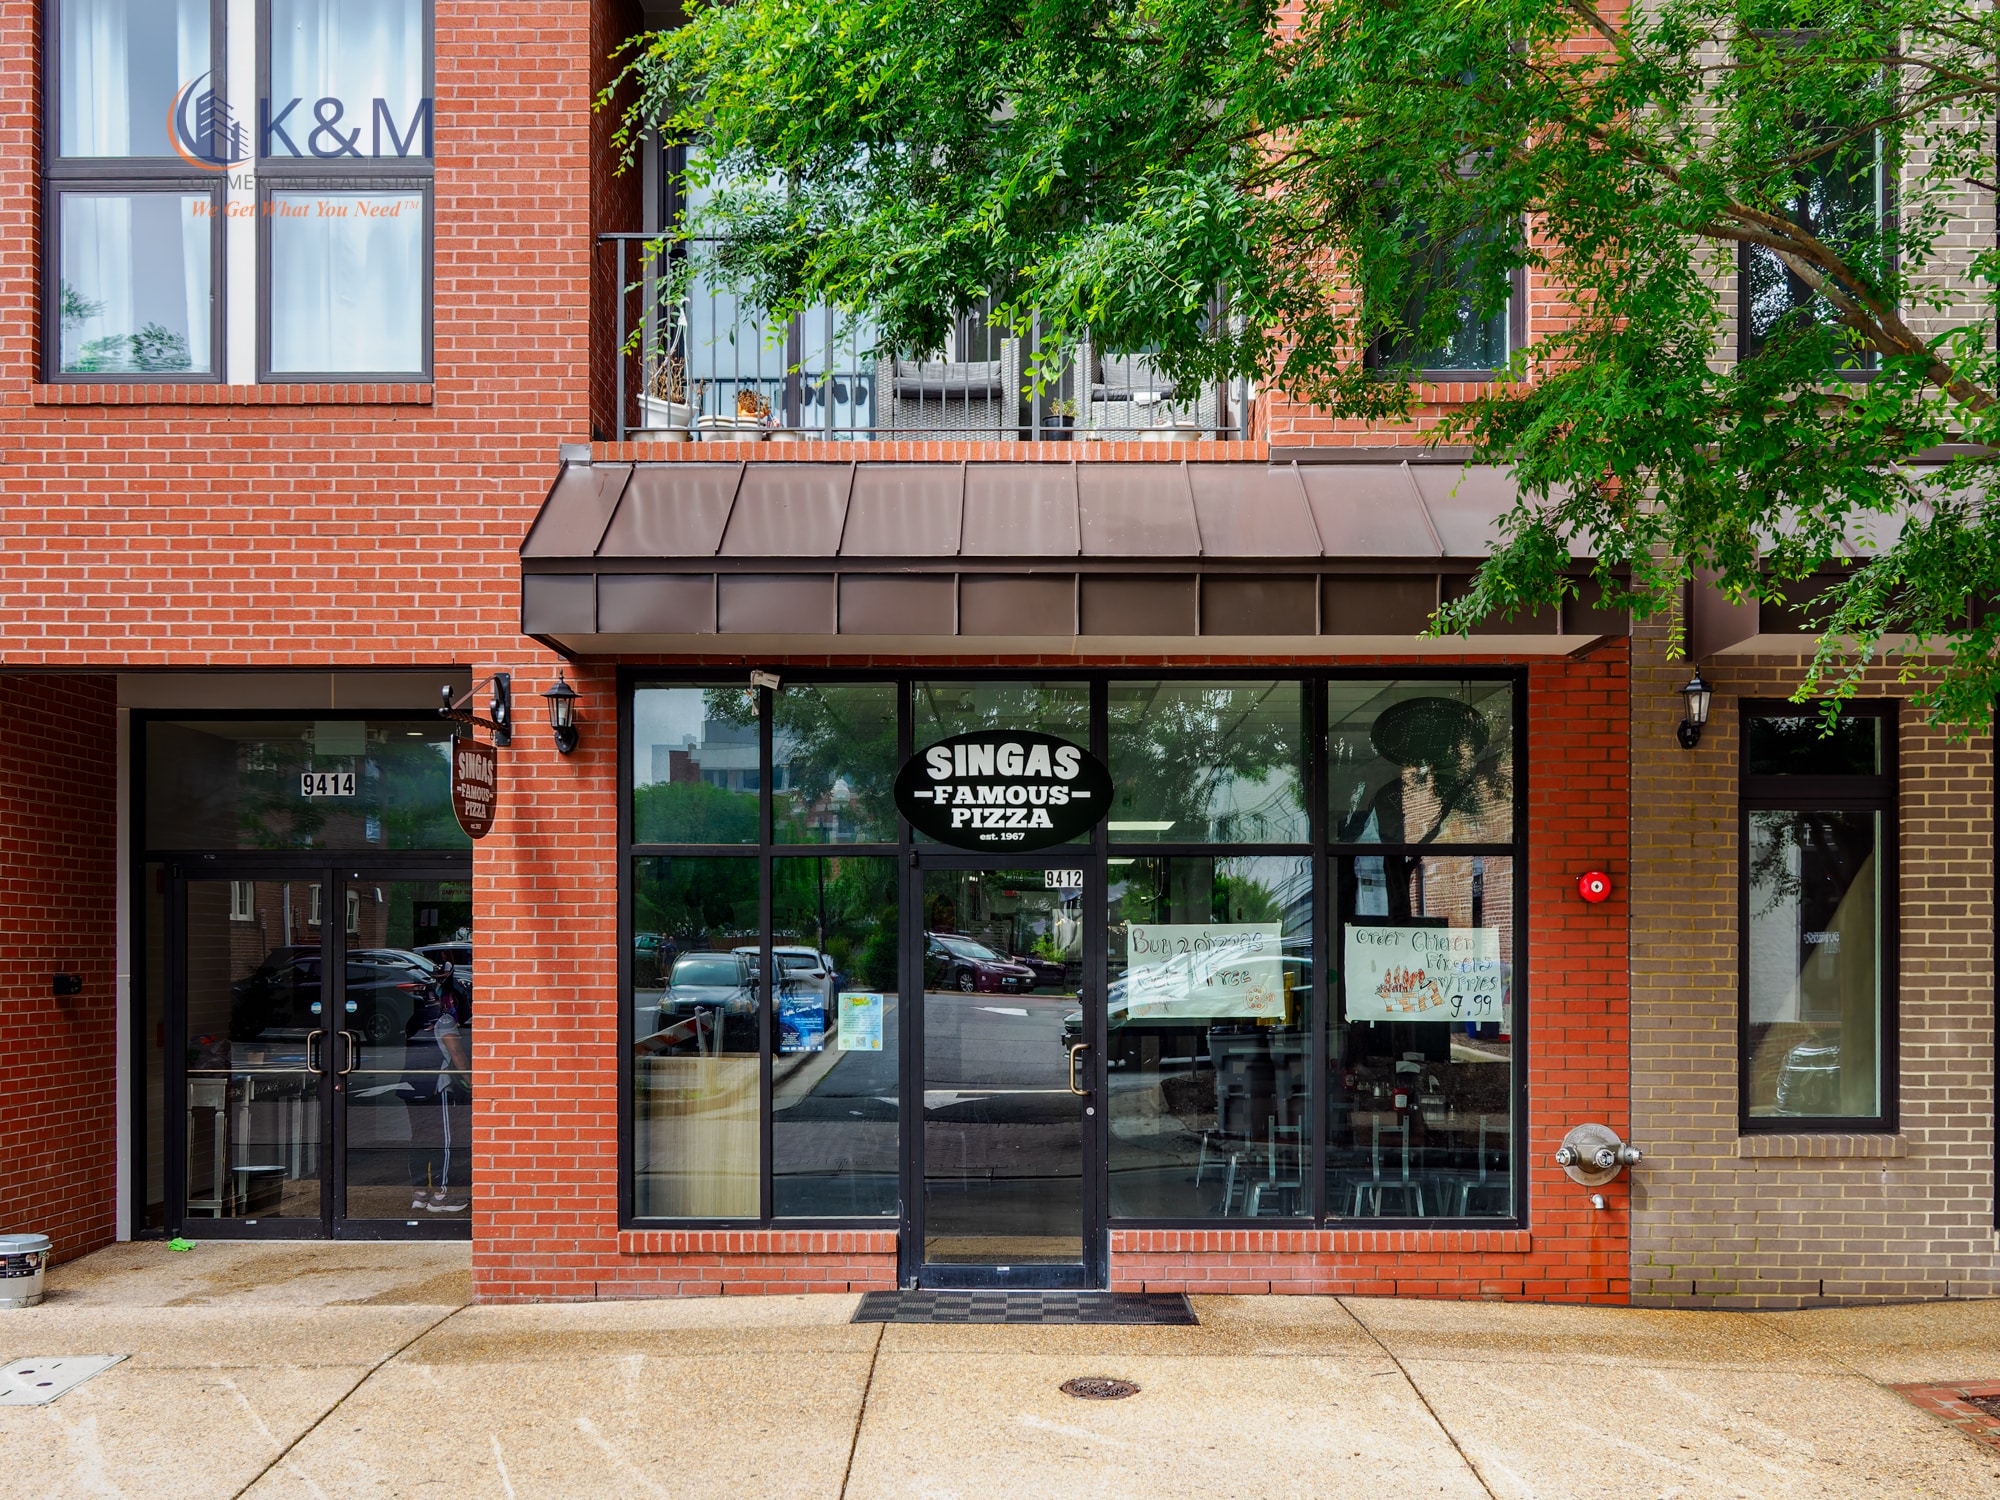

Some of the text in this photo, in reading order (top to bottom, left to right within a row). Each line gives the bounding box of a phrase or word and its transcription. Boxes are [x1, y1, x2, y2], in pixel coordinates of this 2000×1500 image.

[458, 751, 494, 787] SINGAS
[926, 742, 1081, 780] SINGAS
[303, 774, 354, 795] 9414
[464, 800, 487, 819] PIZZA
[951, 808, 1054, 828] PIZZA
[979, 832, 1025, 841] est. 1967
[1046, 871, 1082, 887] 9412
[1177, 936, 1191, 954] 2
[1450, 994, 1492, 1018] 9.99
